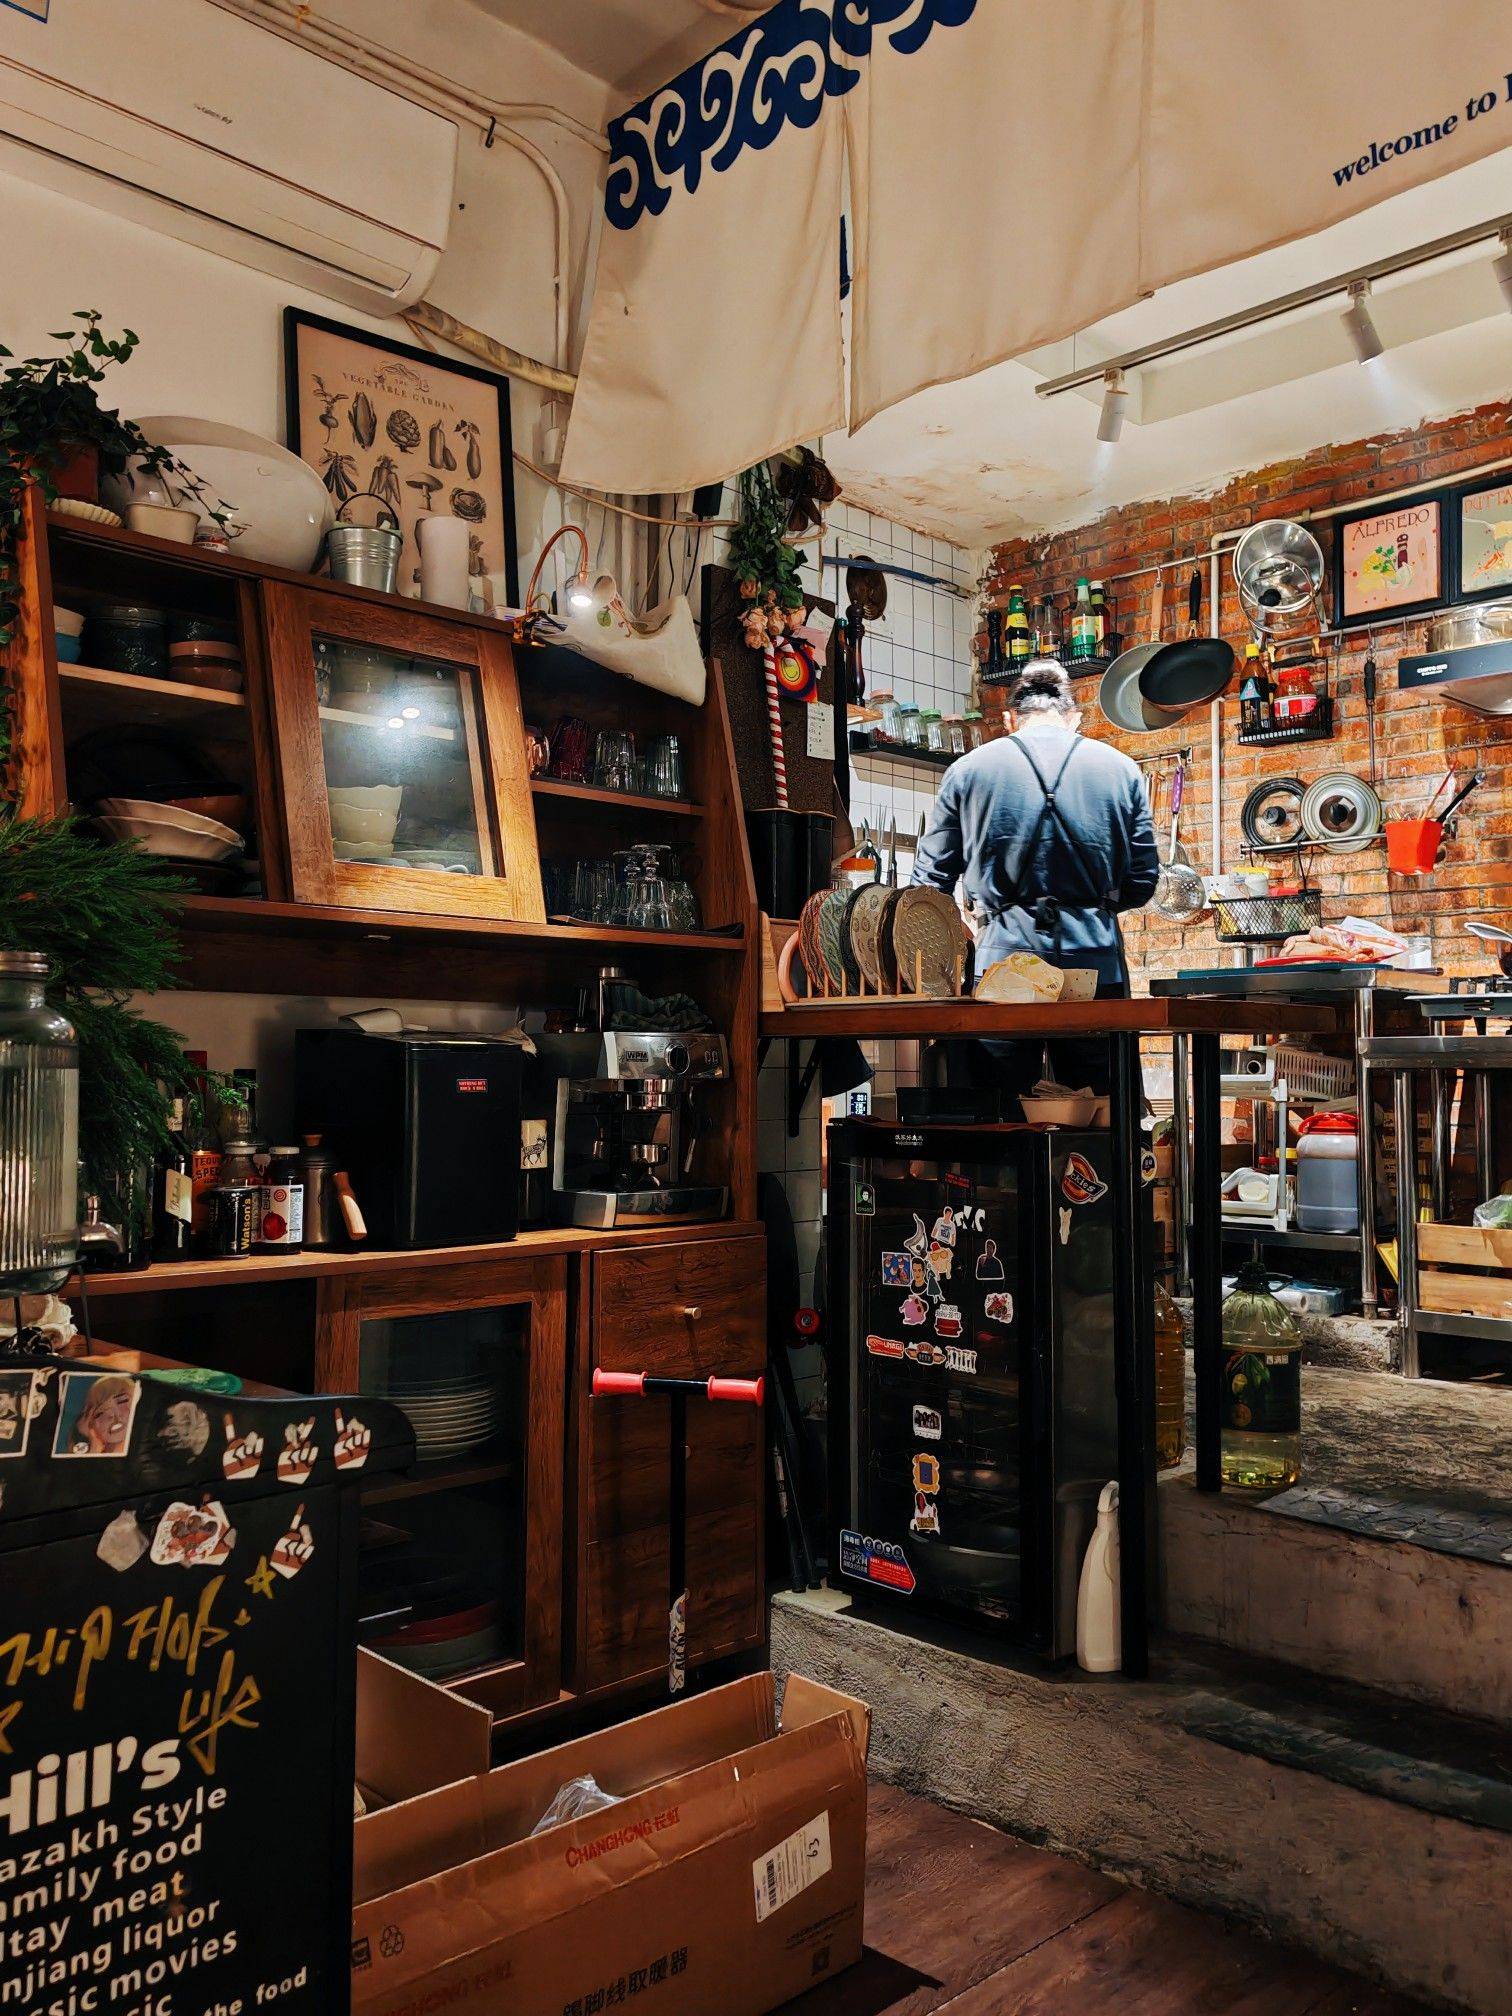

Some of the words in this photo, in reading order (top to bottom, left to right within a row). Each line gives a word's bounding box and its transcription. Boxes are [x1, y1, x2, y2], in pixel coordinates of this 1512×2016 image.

[1332, 114, 1458, 187] welcome
[1466, 91, 1497, 121] to
[1352, 508, 1430, 541] ALFREDO
[195, 1157, 217, 1168] TEQU
[1071, 1172, 1097, 1193] ckies
[241, 1198, 251, 1250] Watson's
[0, 1819, 119, 1884] azakh
[132, 1786, 228, 1837] Style
[564, 1817, 653, 1868] CHANGHONG
[0, 1866, 101, 1922] mily
[112, 1822, 203, 1881] food
[0, 1915, 71, 1964] ltay
[93, 1870, 185, 1928] meat
[2, 1941, 113, 2004] njiang
[123, 1899, 221, 1955] liquor
[29, 1985, 99, 2016] sic
[110, 1930, 238, 2001] movies
[255, 1966, 308, 2005] food
